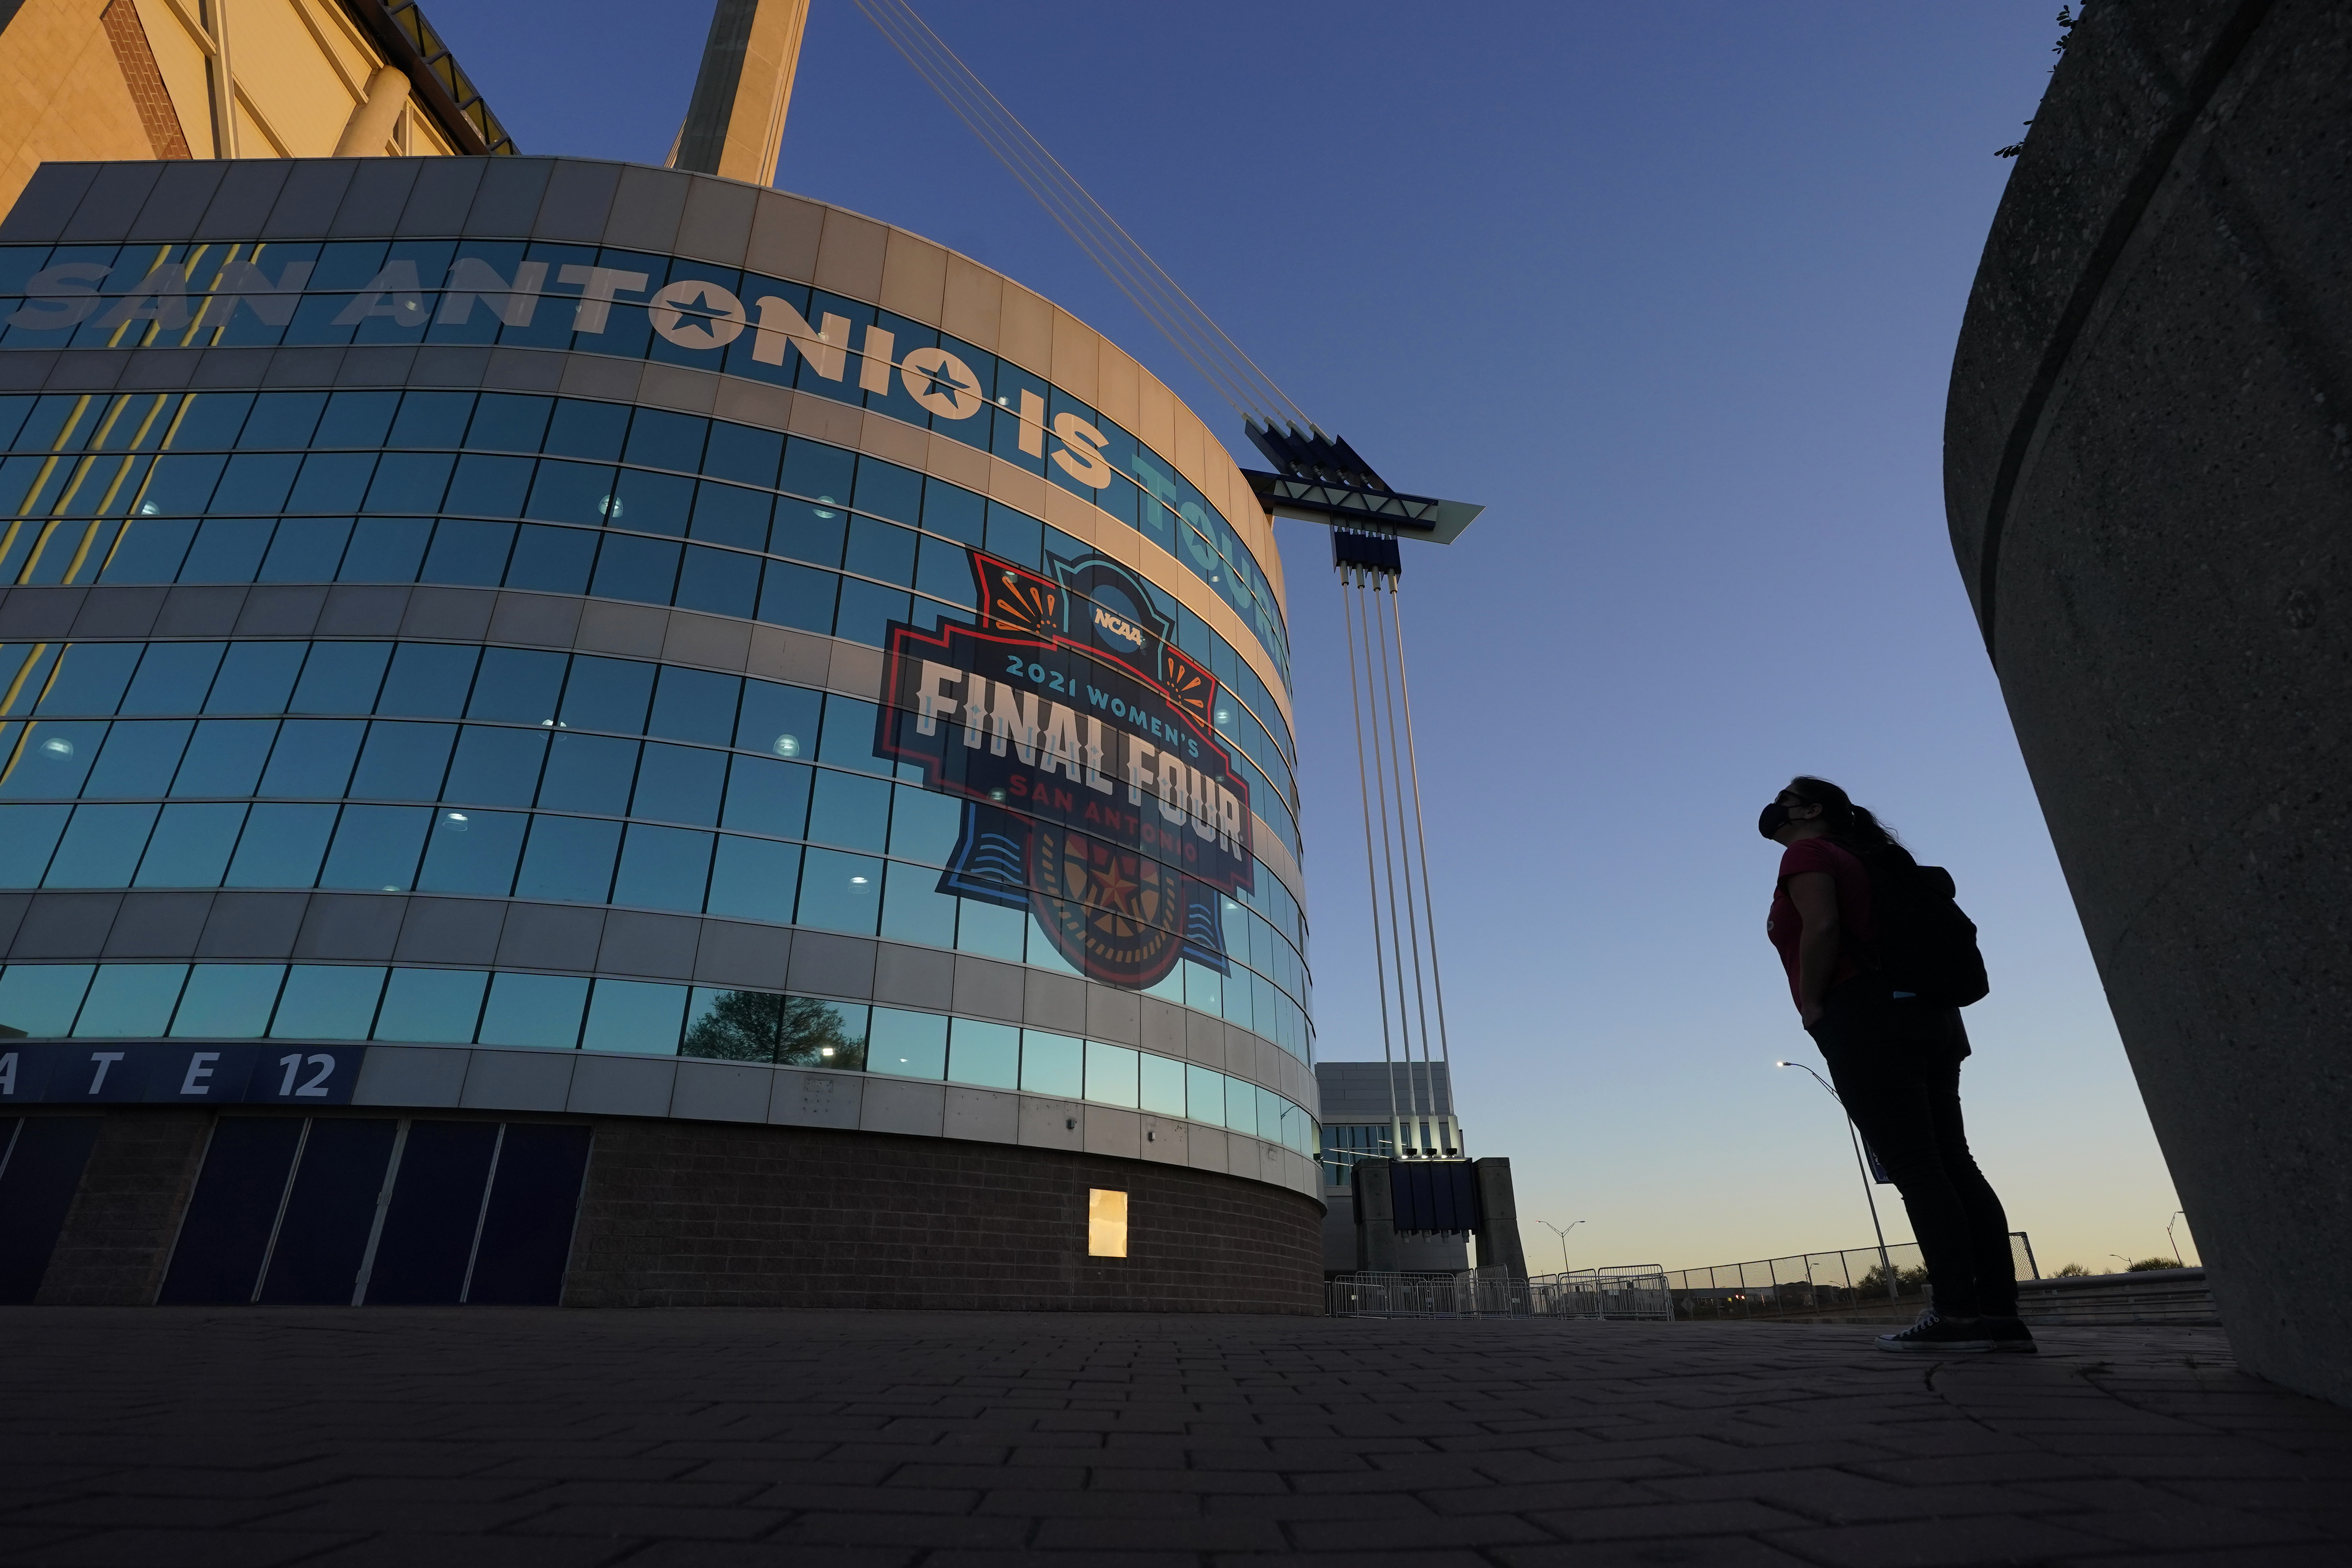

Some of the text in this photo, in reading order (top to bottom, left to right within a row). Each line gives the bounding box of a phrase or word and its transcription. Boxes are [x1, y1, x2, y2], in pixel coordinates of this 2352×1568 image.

[4, 260, 317, 331] SAN
[331, 258, 983, 420] ANTONIO
[1018, 388, 1111, 489] IS
[1094, 608, 1141, 646] NCAA
[1006, 655, 1200, 758] 2021 WOMEN'S
[916, 659, 1242, 862] FINAL FOUR
[1009, 774, 1197, 862] SAN ANTONIO
[279, 1053, 335, 1097] 12
